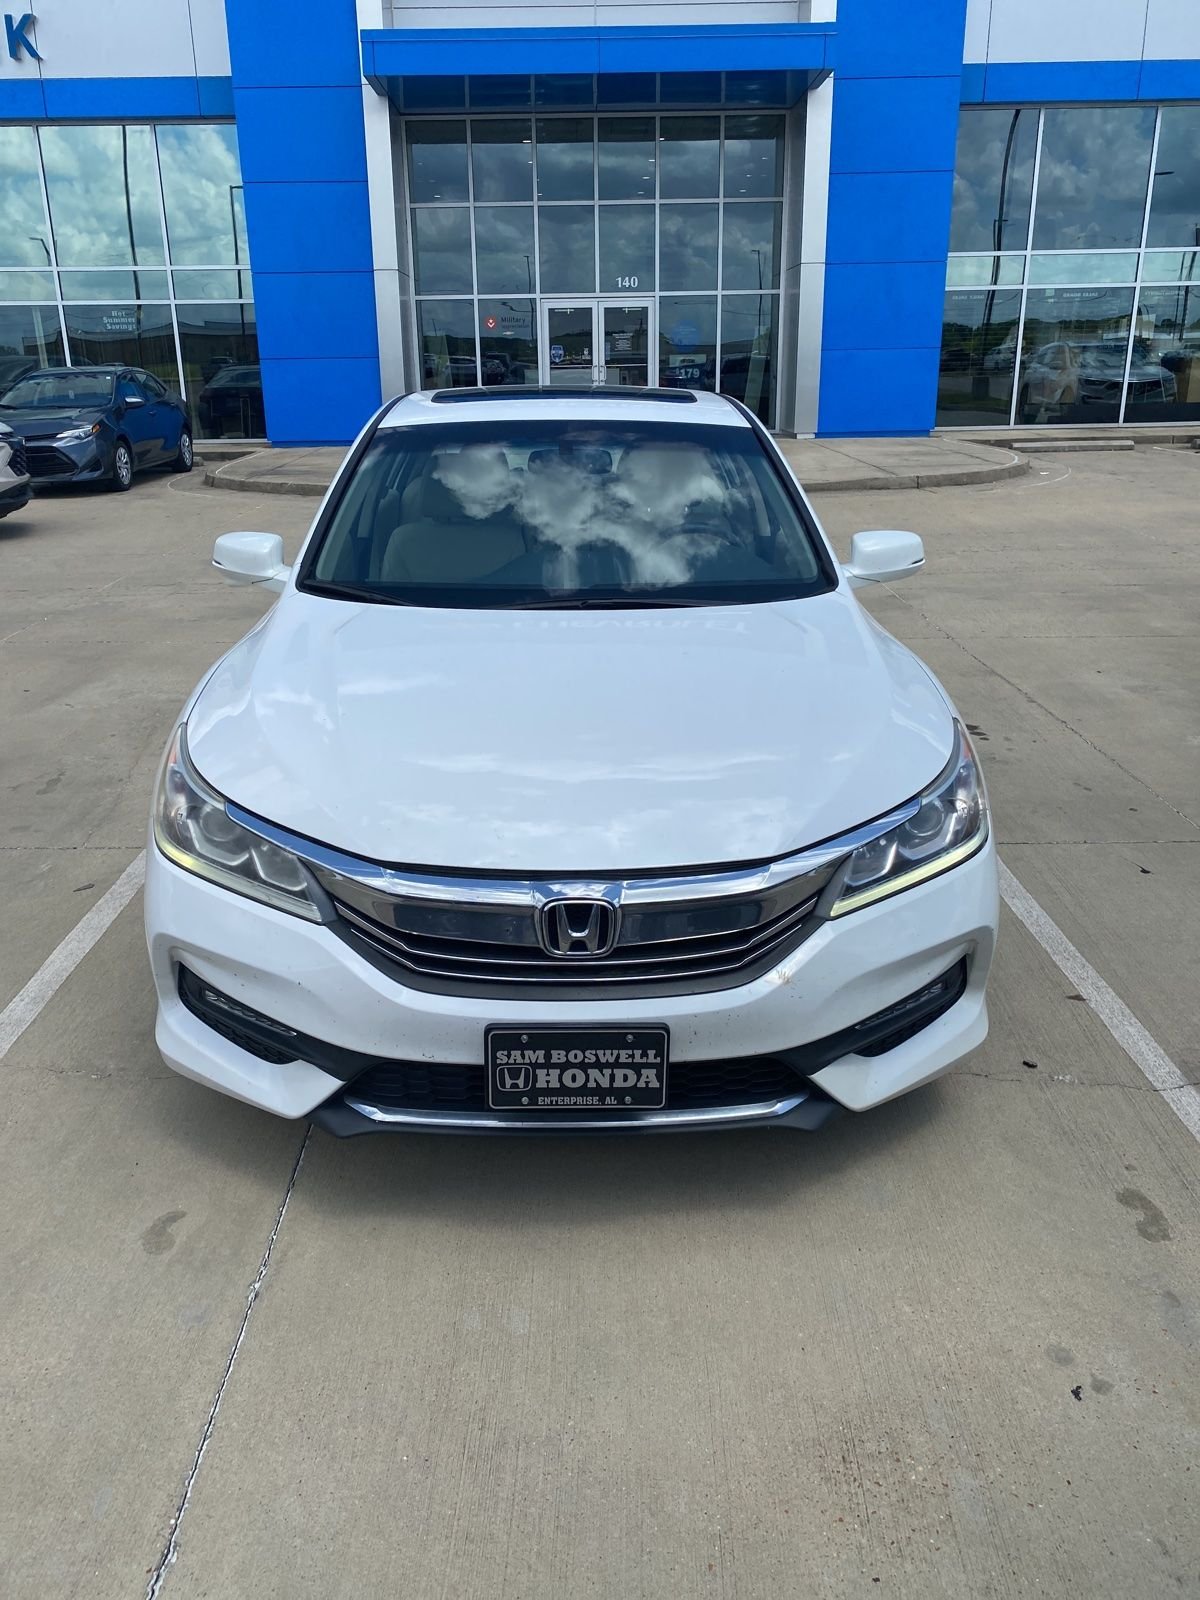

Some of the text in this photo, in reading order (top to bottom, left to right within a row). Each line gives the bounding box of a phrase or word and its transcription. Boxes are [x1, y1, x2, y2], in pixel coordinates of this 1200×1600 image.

[615, 276, 639, 288] 140
[501, 316, 526, 324] Military
[496, 1049, 661, 1064] SAM BOSWELL
[535, 1068, 660, 1088] HONDA
[605, 1096, 618, 1105] AL
